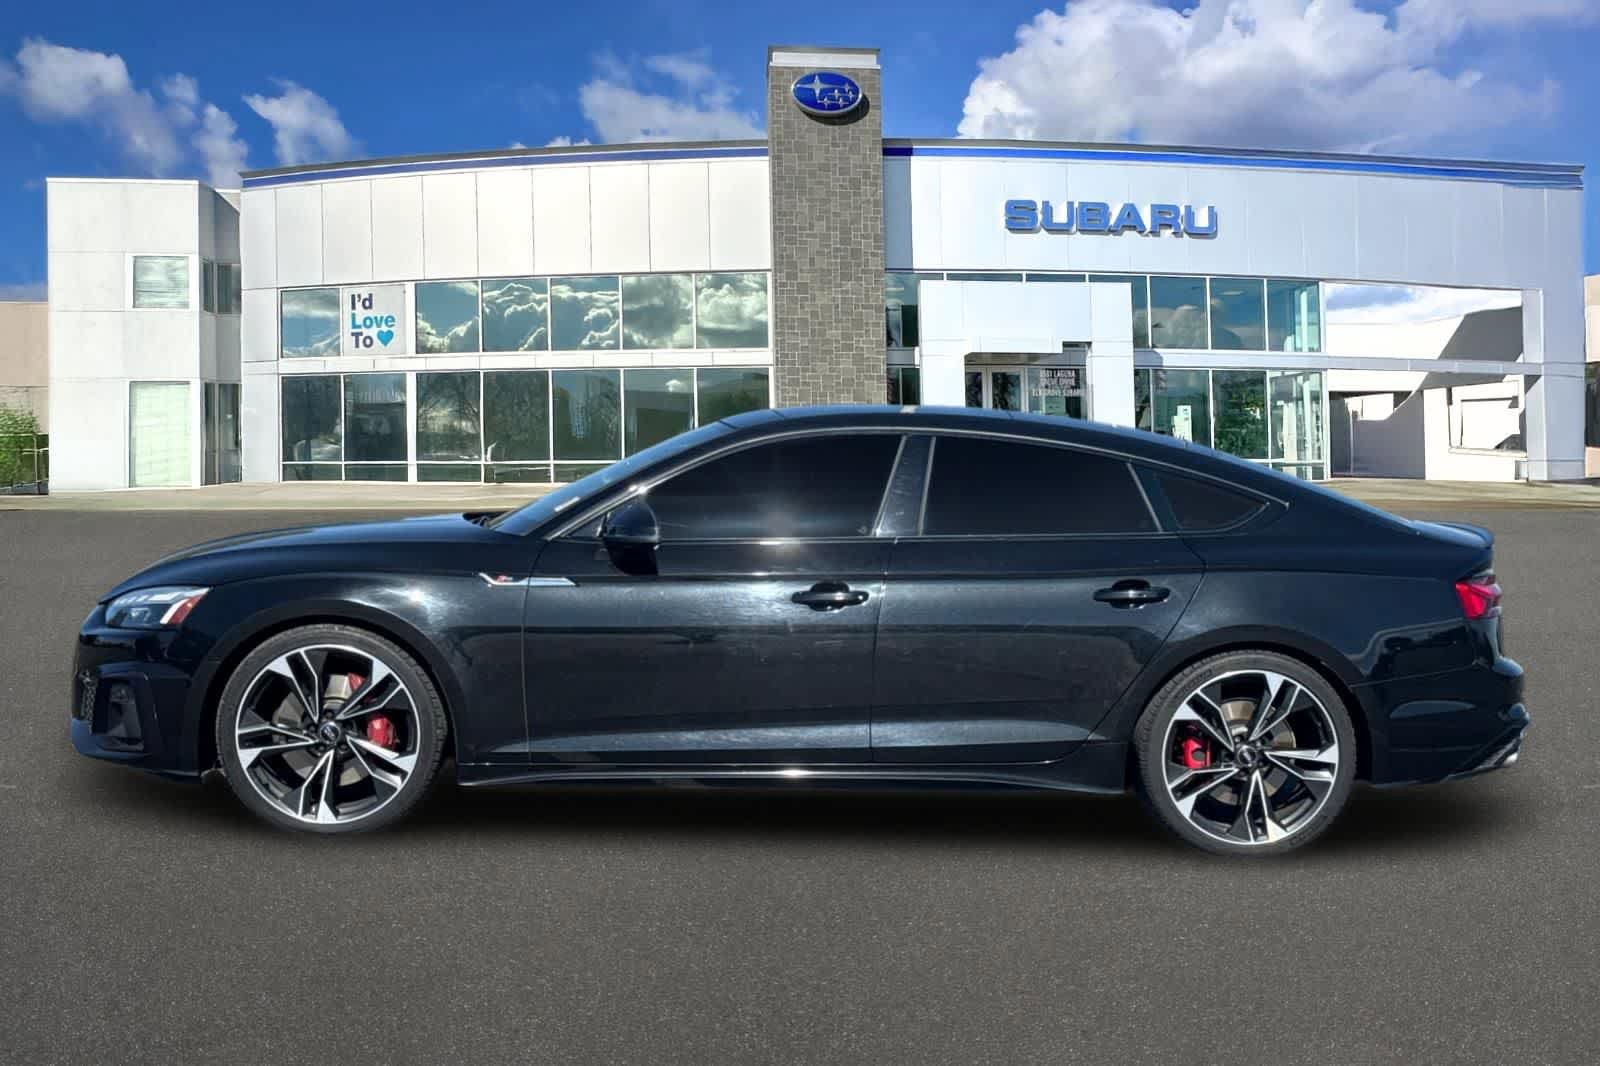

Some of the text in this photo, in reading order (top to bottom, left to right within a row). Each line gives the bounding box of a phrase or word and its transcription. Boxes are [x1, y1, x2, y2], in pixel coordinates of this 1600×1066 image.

[1004, 199, 1217, 237] SUBARU
[351, 293, 373, 310] I'd
[351, 312, 396, 329] Love
[350, 331, 374, 348] To
